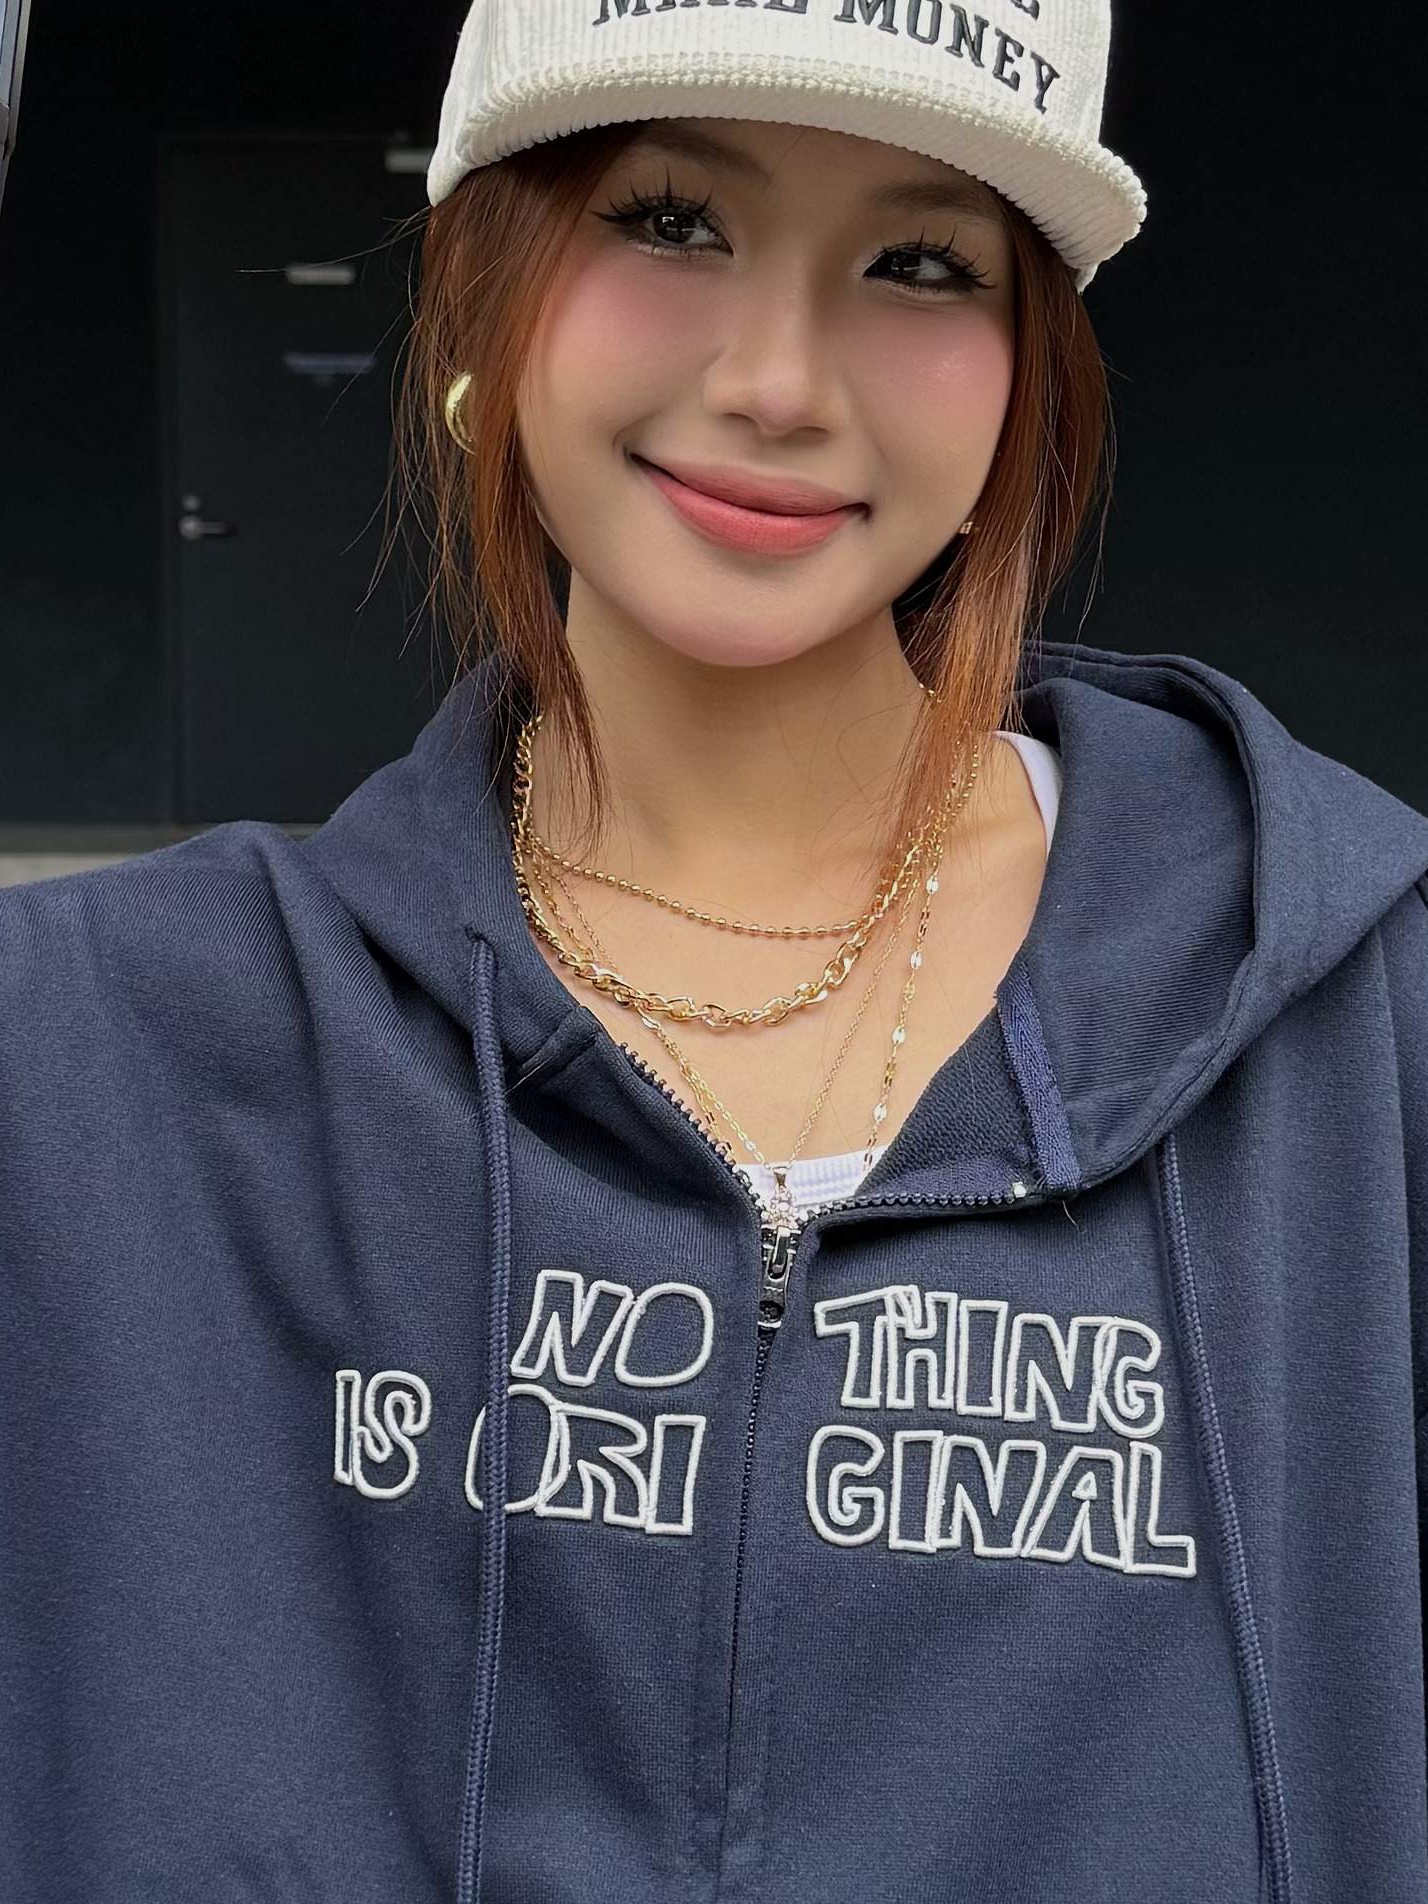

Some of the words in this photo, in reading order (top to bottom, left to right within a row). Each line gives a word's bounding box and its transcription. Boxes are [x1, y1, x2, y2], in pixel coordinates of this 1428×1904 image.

[509, 1269, 714, 1388] NO
[814, 1284, 1164, 1438] THING
[334, 1369, 432, 1500] IS
[465, 1384, 706, 1536] ORI
[806, 1425, 1197, 1579] GINAL
